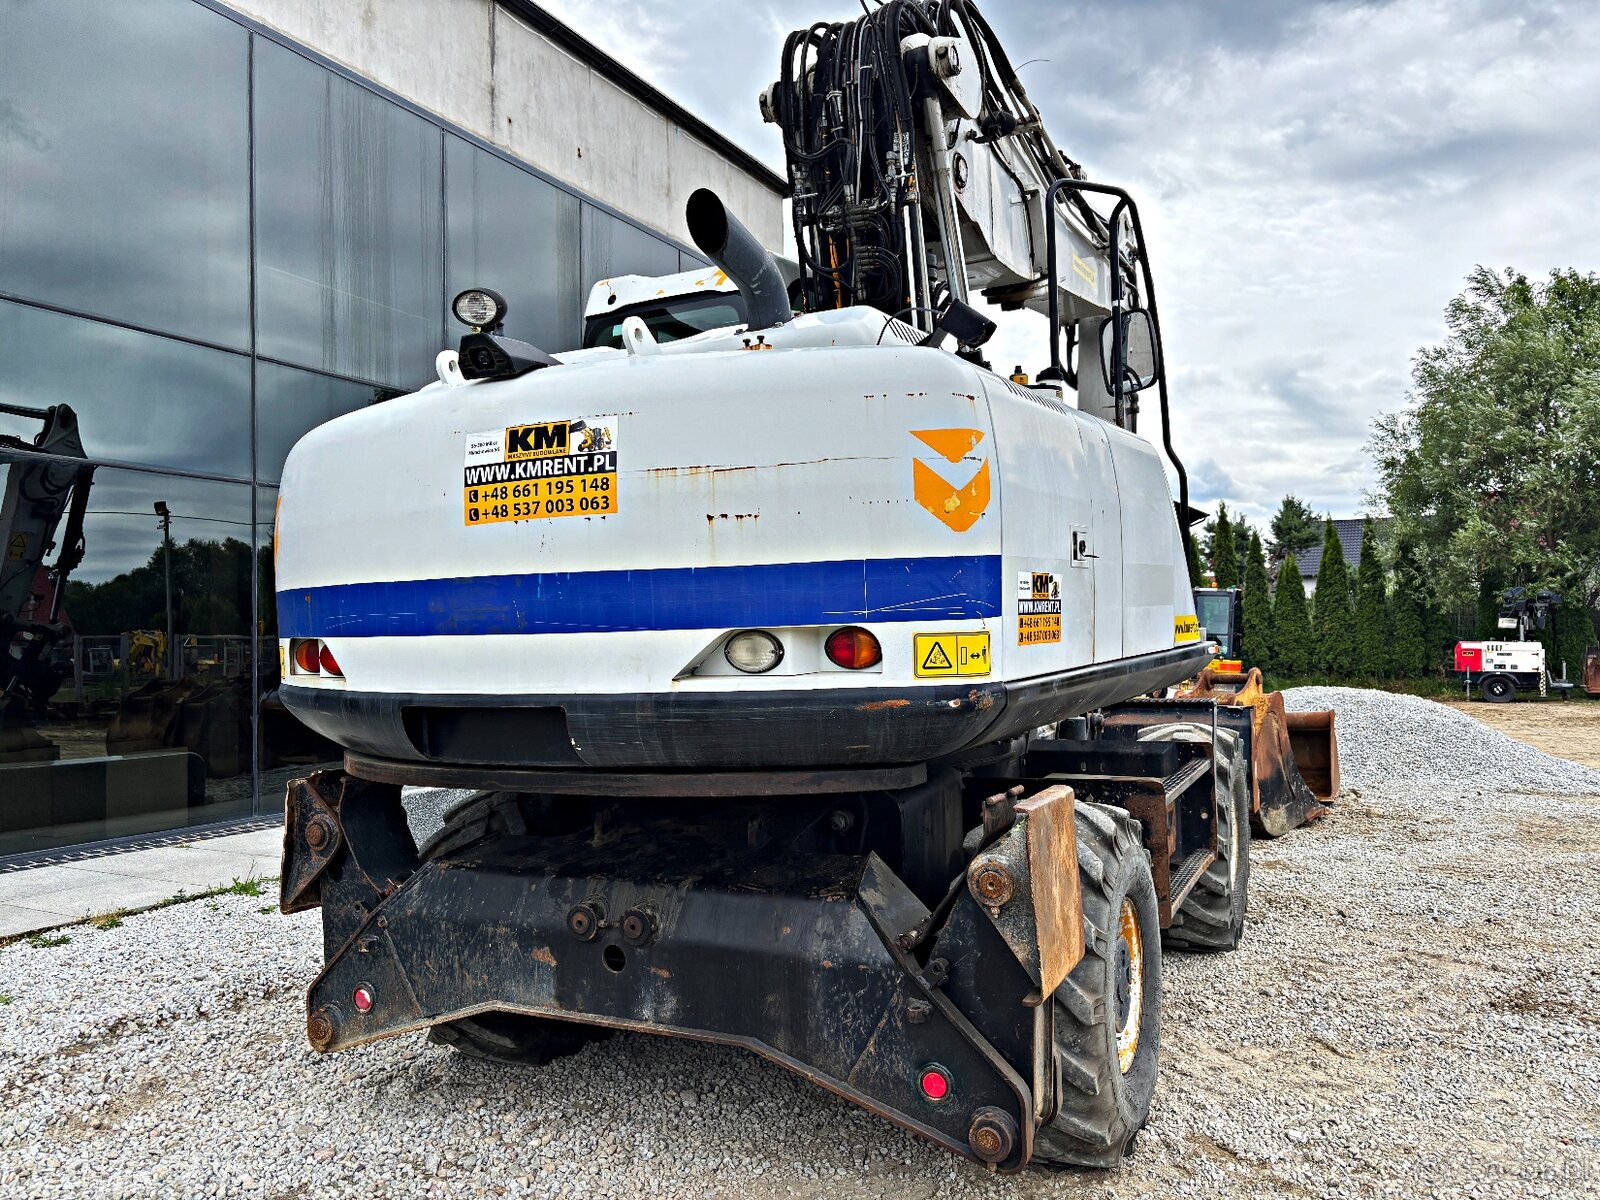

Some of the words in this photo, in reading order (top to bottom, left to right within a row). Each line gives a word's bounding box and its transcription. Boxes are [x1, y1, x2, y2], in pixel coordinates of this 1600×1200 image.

[508, 424, 567, 453] KM
[508, 451, 532, 459] MASZYNY
[533, 448, 567, 457] BUDOWLANE
[466, 454, 615, 485] WWW.KMRENT.PL
[482, 485, 508, 501] +48
[513, 483, 539, 498] 661
[546, 480, 574, 495] 195
[581, 477, 610, 492] 148
[482, 504, 508, 519] +48
[513, 501, 540, 517] 537
[545, 498, 574, 513] 003
[580, 495, 610, 511] 063
[1032, 575, 1049, 593] KM
